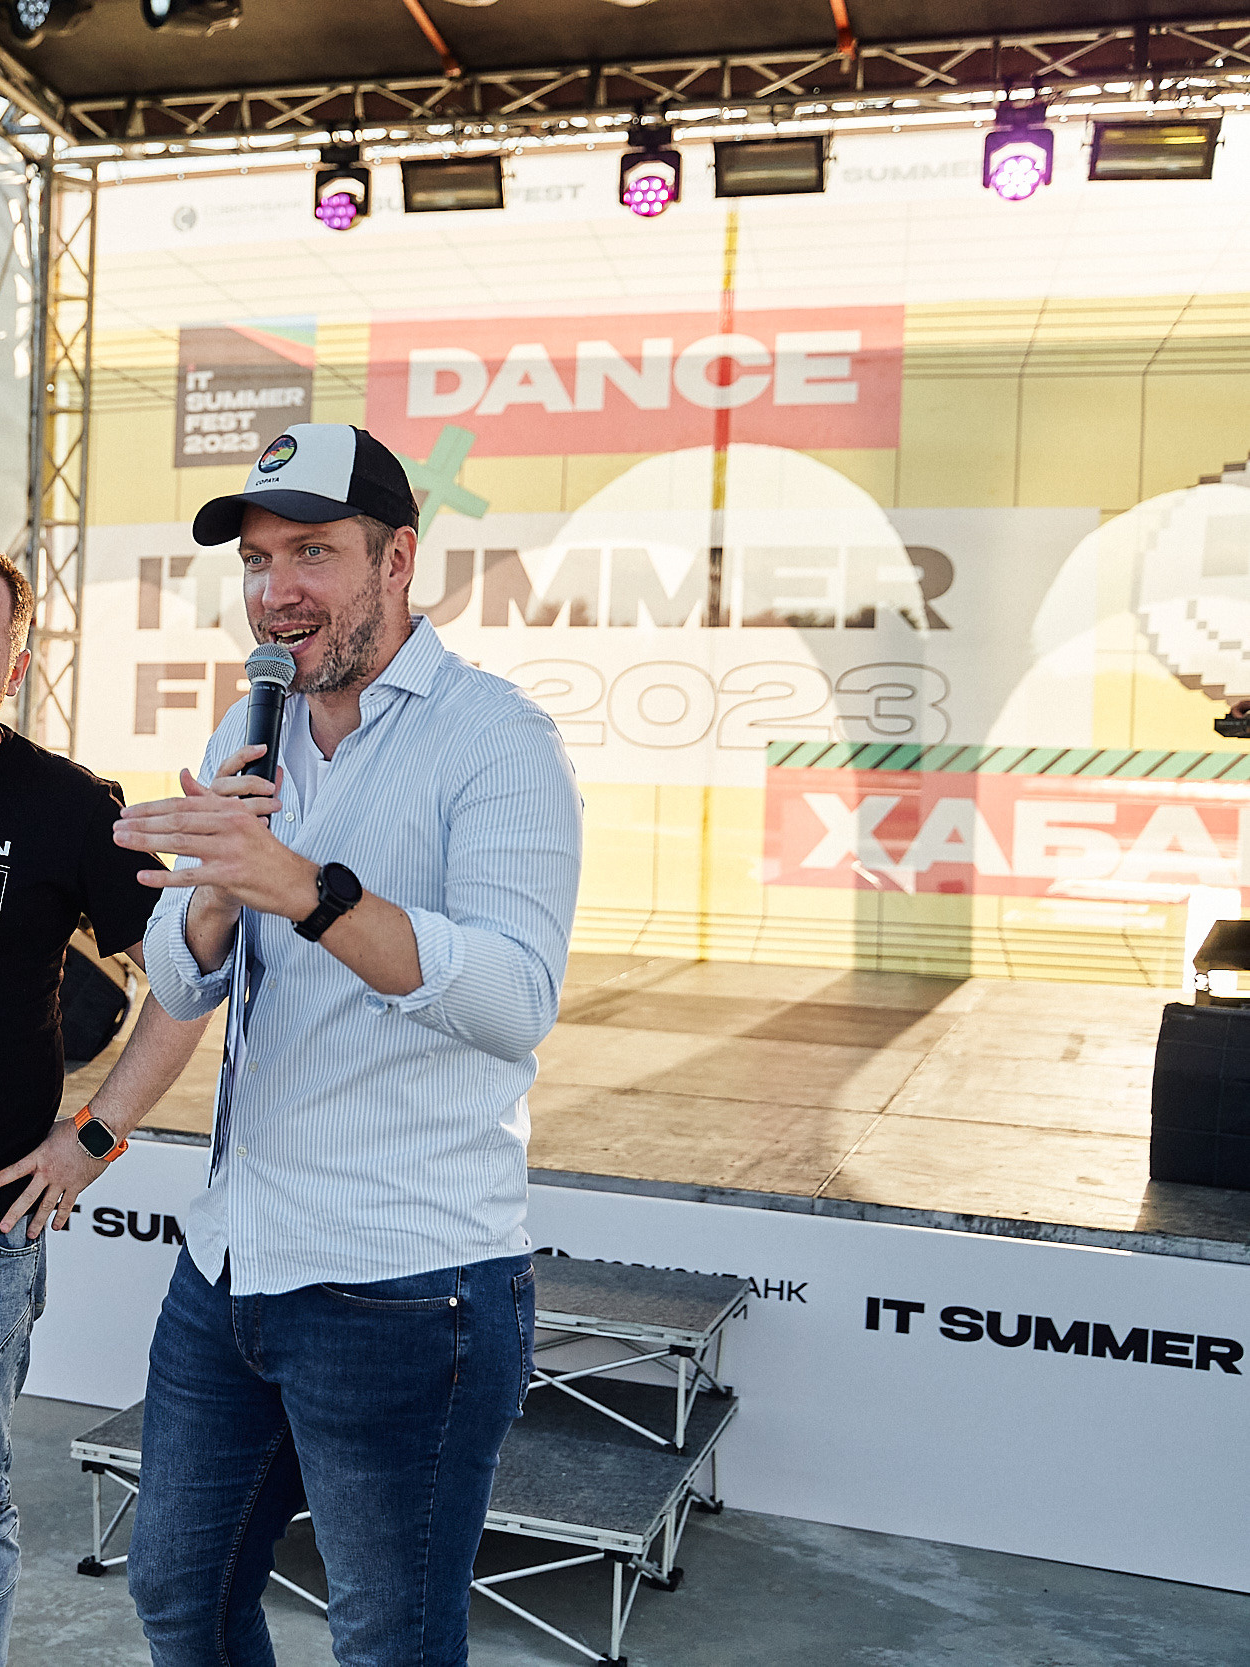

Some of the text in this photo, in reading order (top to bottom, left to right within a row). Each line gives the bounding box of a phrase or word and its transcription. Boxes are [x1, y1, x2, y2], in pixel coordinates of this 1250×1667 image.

[842, 158, 980, 184] SUMME
[186, 365, 215, 392] IT
[406, 330, 862, 418] DANCE
[185, 386, 306, 413] SUMMER
[183, 409, 257, 434] FEST
[182, 431, 261, 455] 2023
[409, 547, 954, 630] UMMER
[505, 658, 952, 750] 2023
[799, 792, 1250, 887] ХАБА
[92, 1207, 185, 1246] SUM
[865, 1296, 1245, 1376] IT SUMMER
